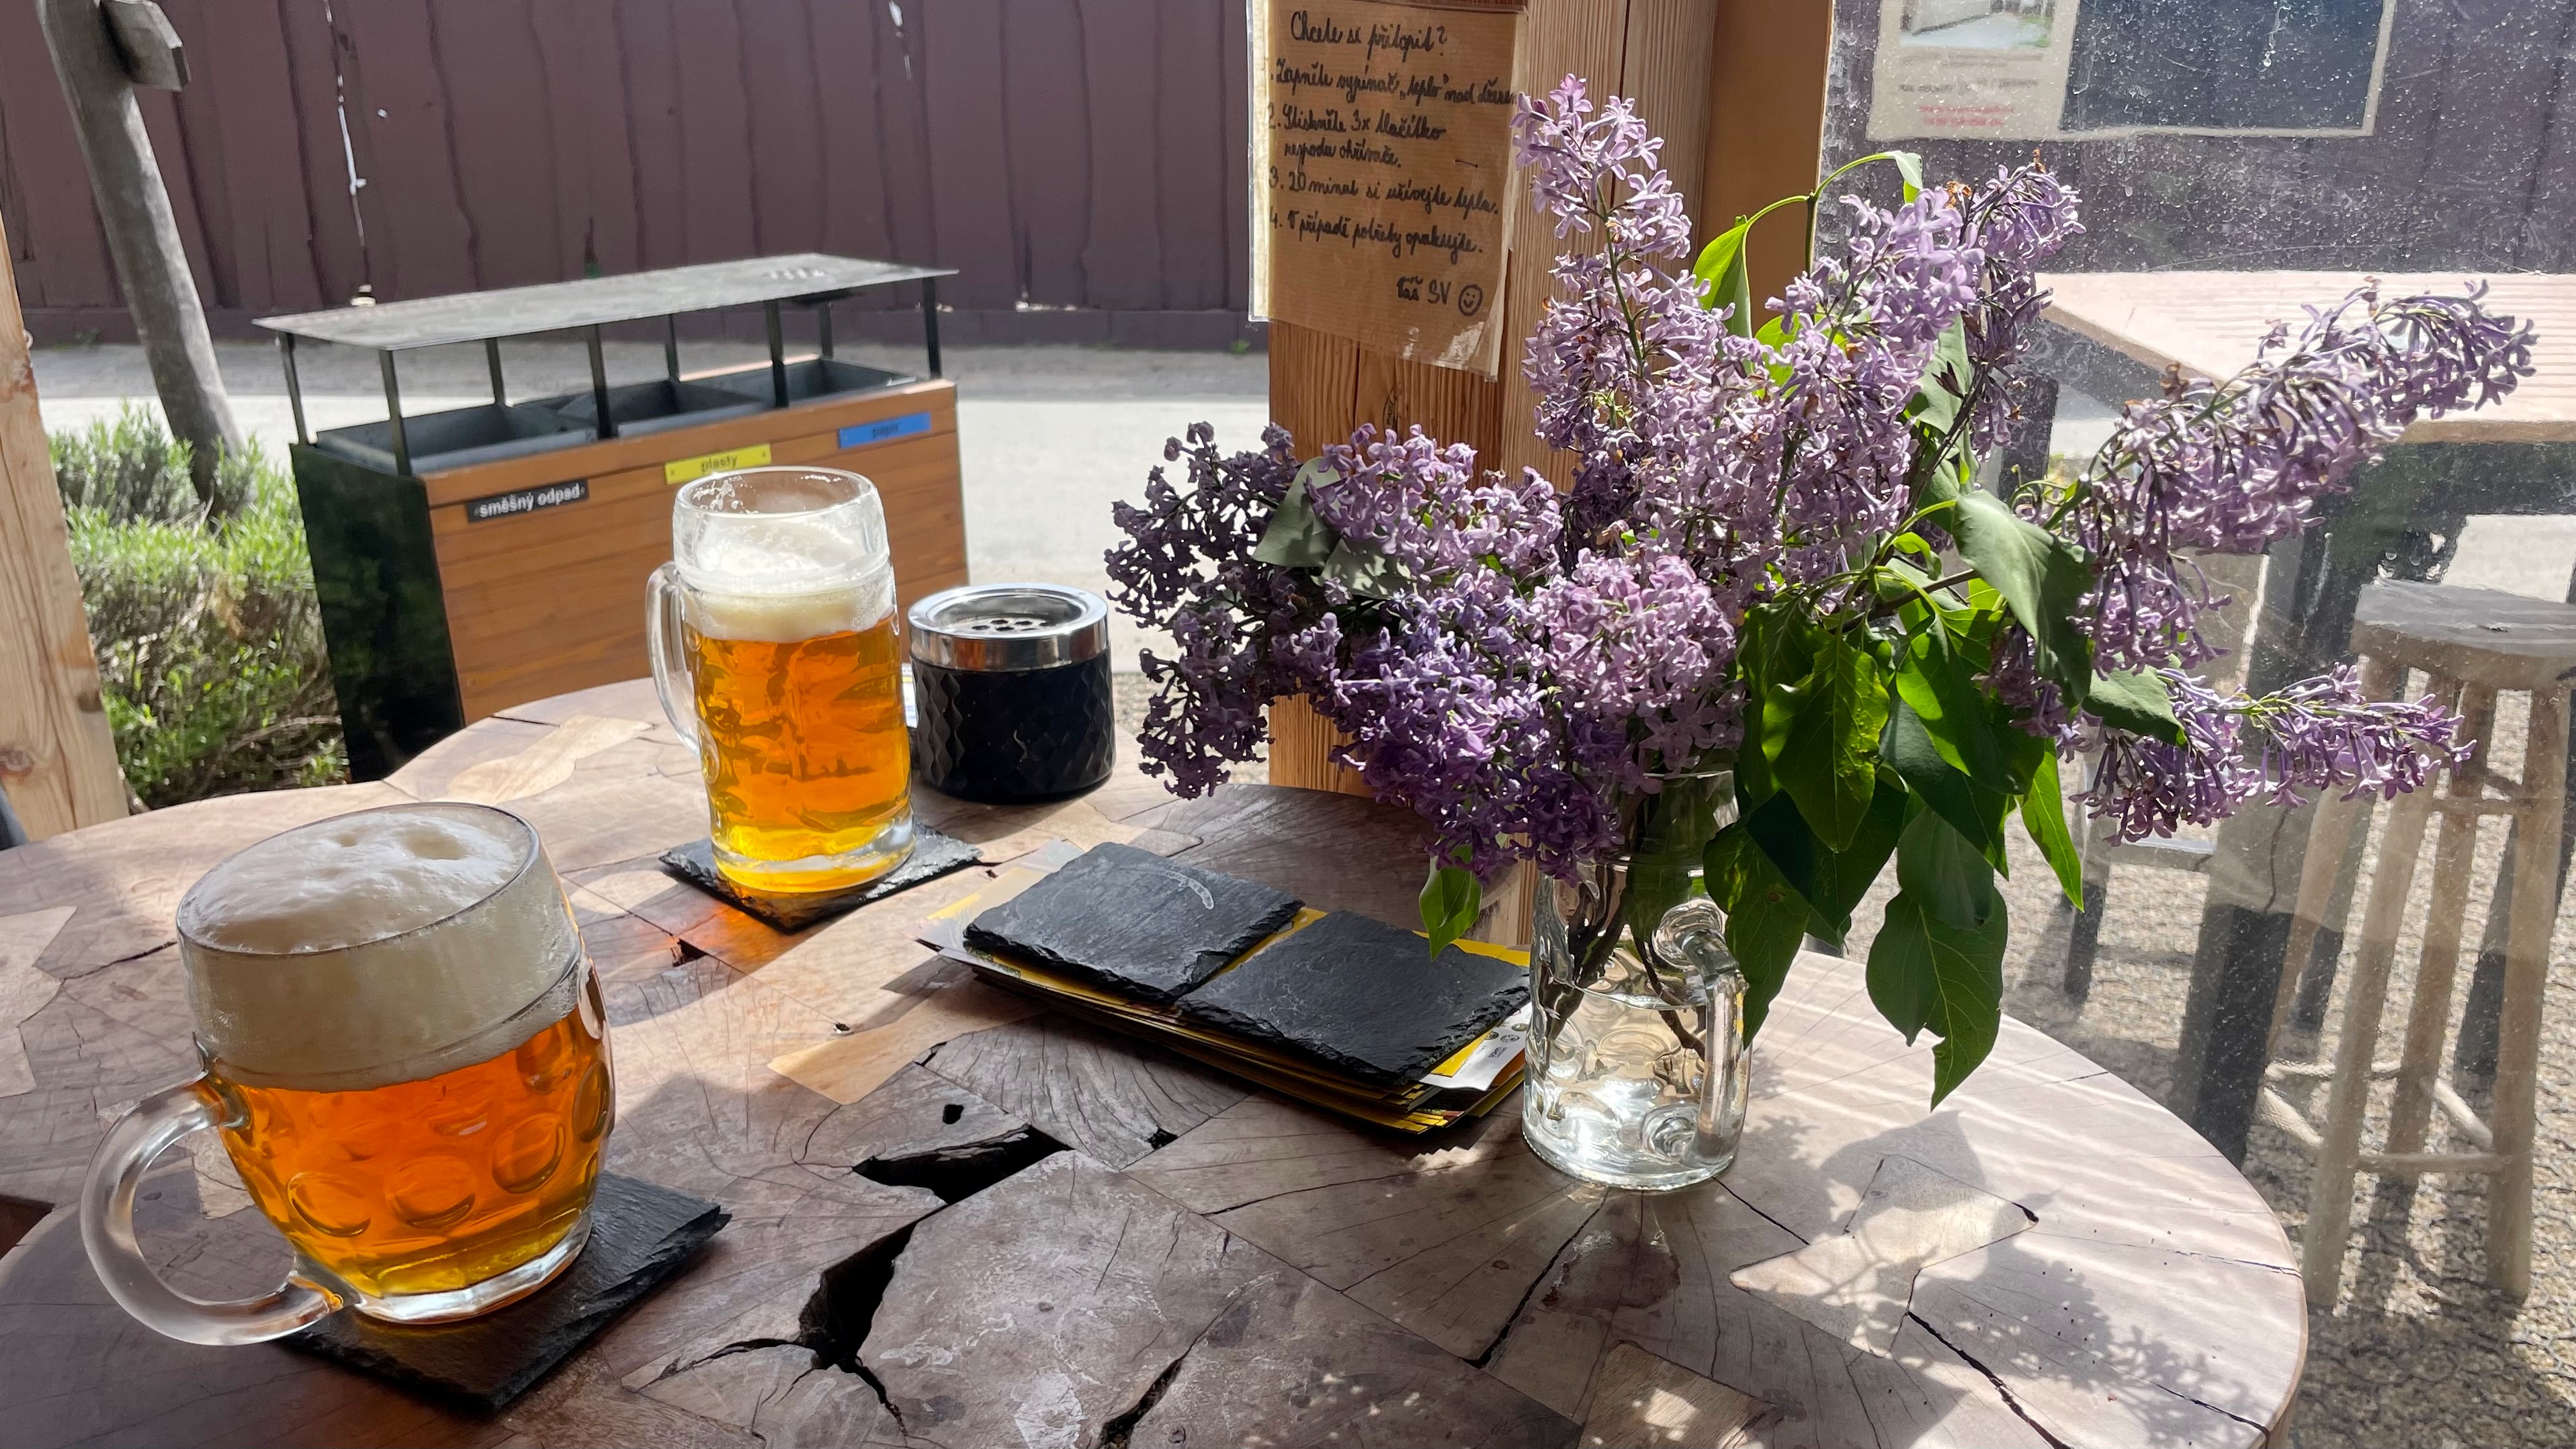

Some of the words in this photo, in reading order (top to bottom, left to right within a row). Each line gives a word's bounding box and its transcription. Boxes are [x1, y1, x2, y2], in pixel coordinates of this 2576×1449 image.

[1291, 10, 1343, 44] Chcete
[1346, 26, 1362, 44] si
[1276, 58, 1333, 96] Zapněte
[1336, 64, 1400, 103] vypínač
[1283, 103, 1347, 133] Stiskněte
[1375, 109, 1447, 141] tlačítko
[1269, 166, 1284, 189] 3.
[1289, 171, 1307, 192] 20
[1308, 177, 1359, 196] minut
[1365, 181, 1381, 200] si
[1385, 179, 1452, 215] užívejte
[1299, 210, 1352, 243] případě
[1352, 217, 1402, 259] potřeby
[538, 482, 581, 506] odpad
